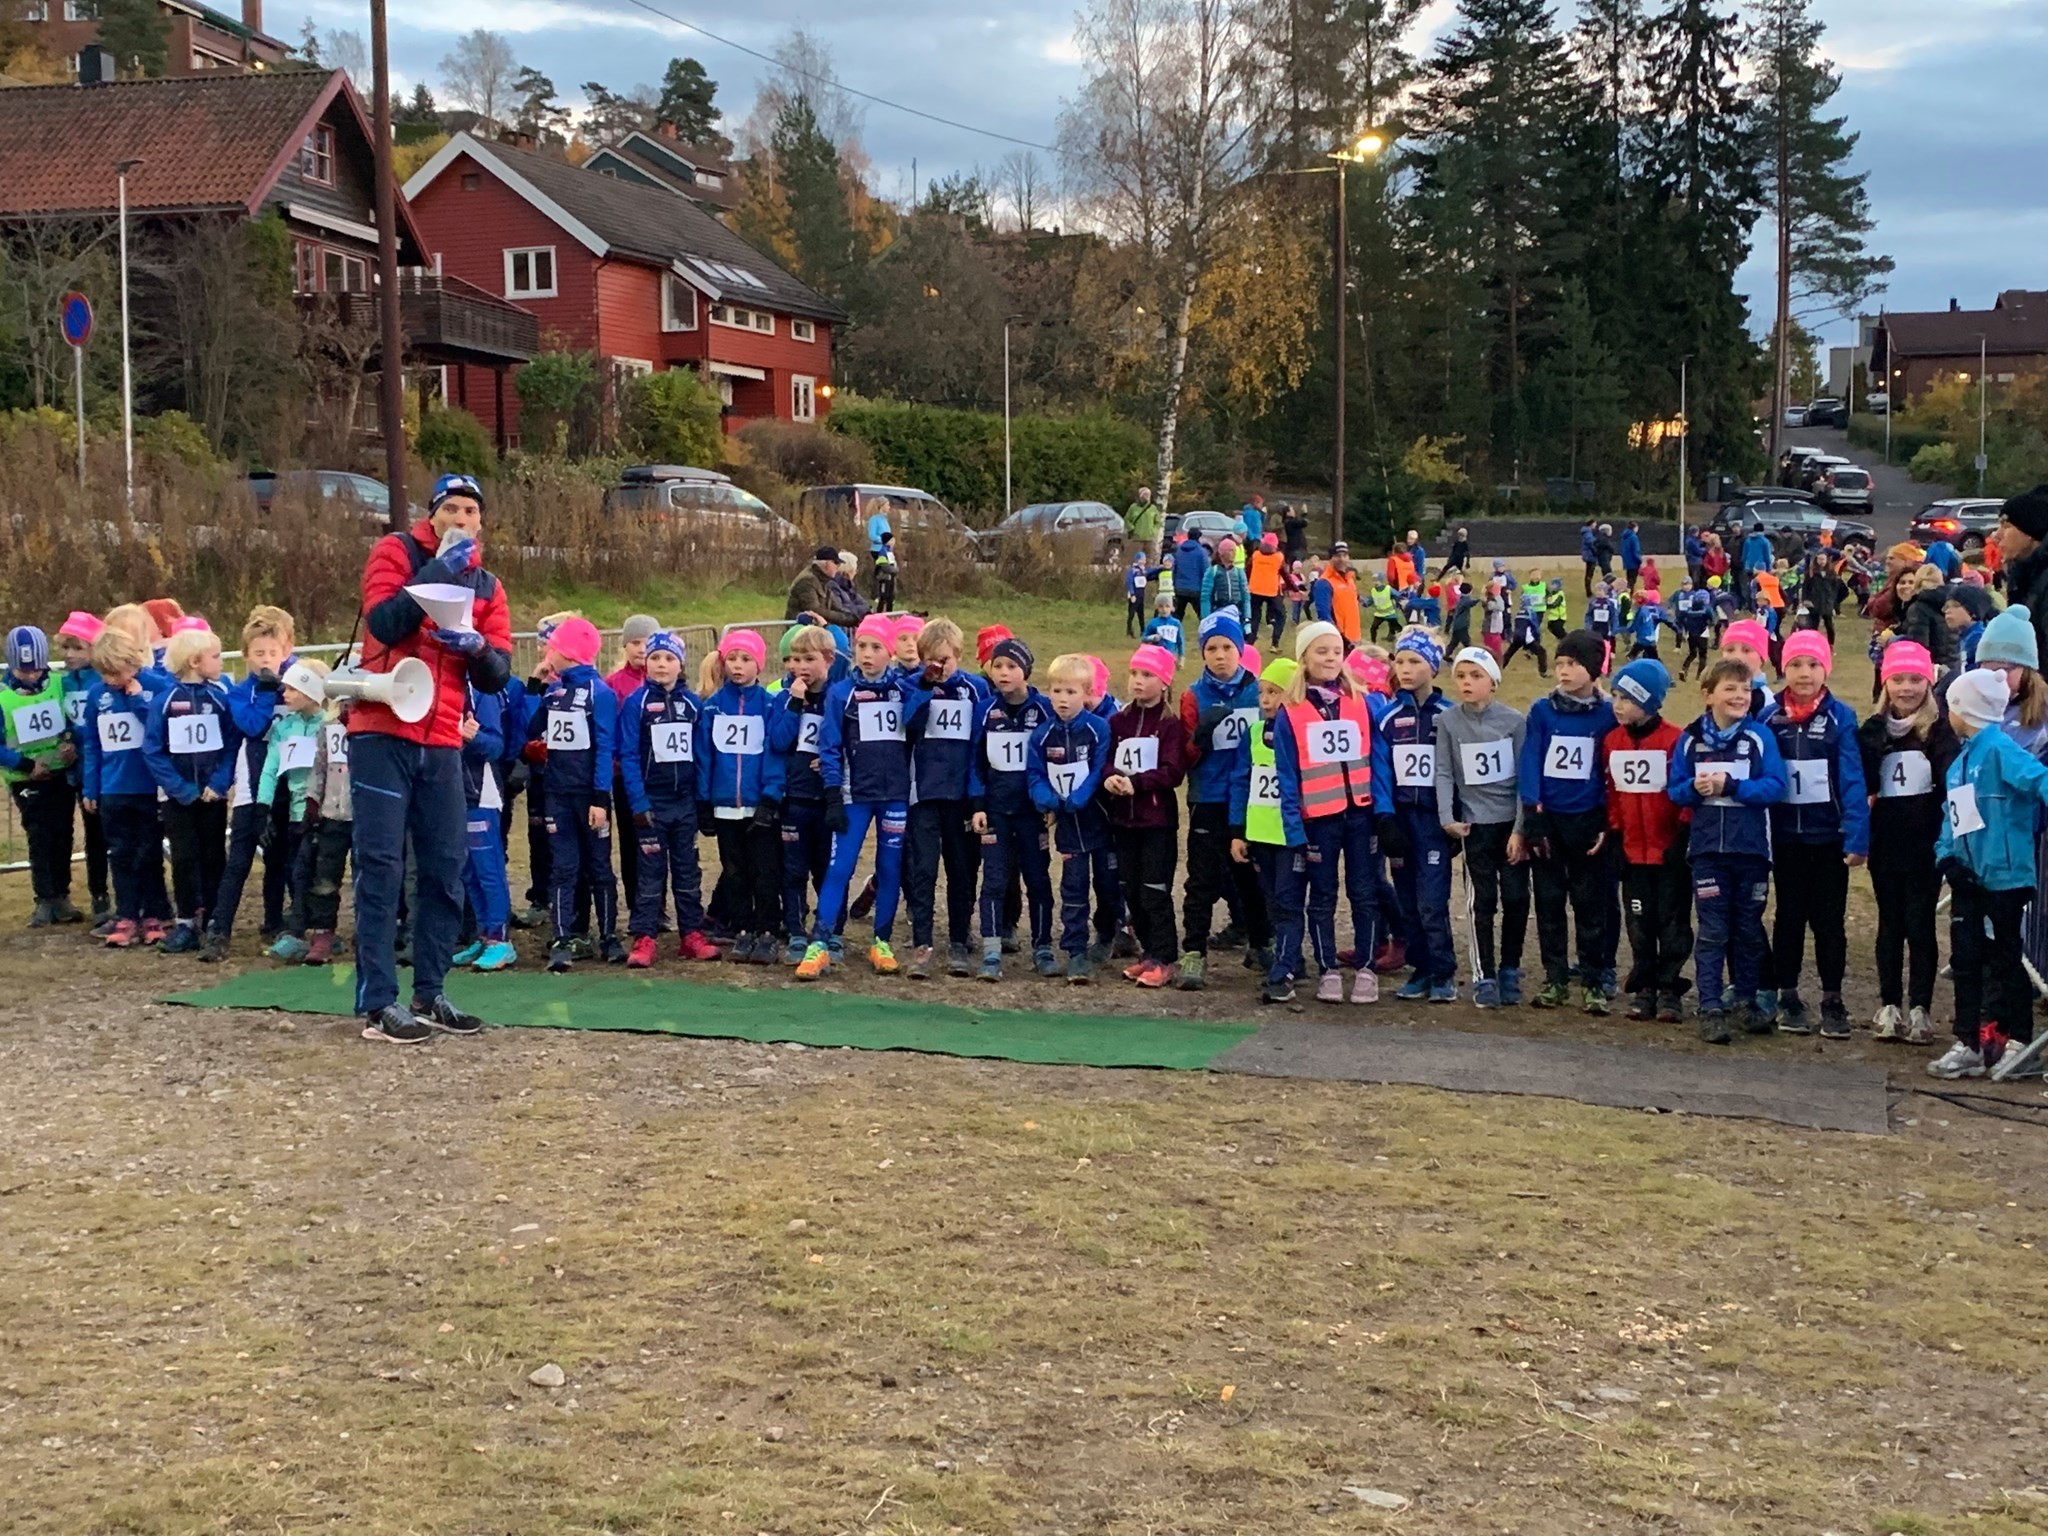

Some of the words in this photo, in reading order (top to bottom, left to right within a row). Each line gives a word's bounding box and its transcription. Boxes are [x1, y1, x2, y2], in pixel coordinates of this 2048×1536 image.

[29, 710, 53, 732] 46
[552, 720, 575, 742] 25
[874, 710, 897, 732] 19
[936, 708, 962, 731] 44
[1225, 717, 1248, 740] 20
[107, 720, 132, 743] 42
[185, 723, 207, 745] 10
[666, 732, 689, 753] 45
[725, 724, 748, 746] 21
[804, 722, 821, 746] 2
[1322, 730, 1350, 754] 35
[1002, 741, 1023, 763] 11
[1123, 748, 1142, 769] 41
[1475, 751, 1501, 776] 31
[1555, 745, 1583, 770] 24
[1405, 753, 1431, 778] 26
[1623, 760, 1650, 784] 52
[1892, 762, 1906, 786] 4
[1056, 772, 1075, 795] 17
[1259, 775, 1281, 799] 23
[1950, 801, 1960, 828] 3
